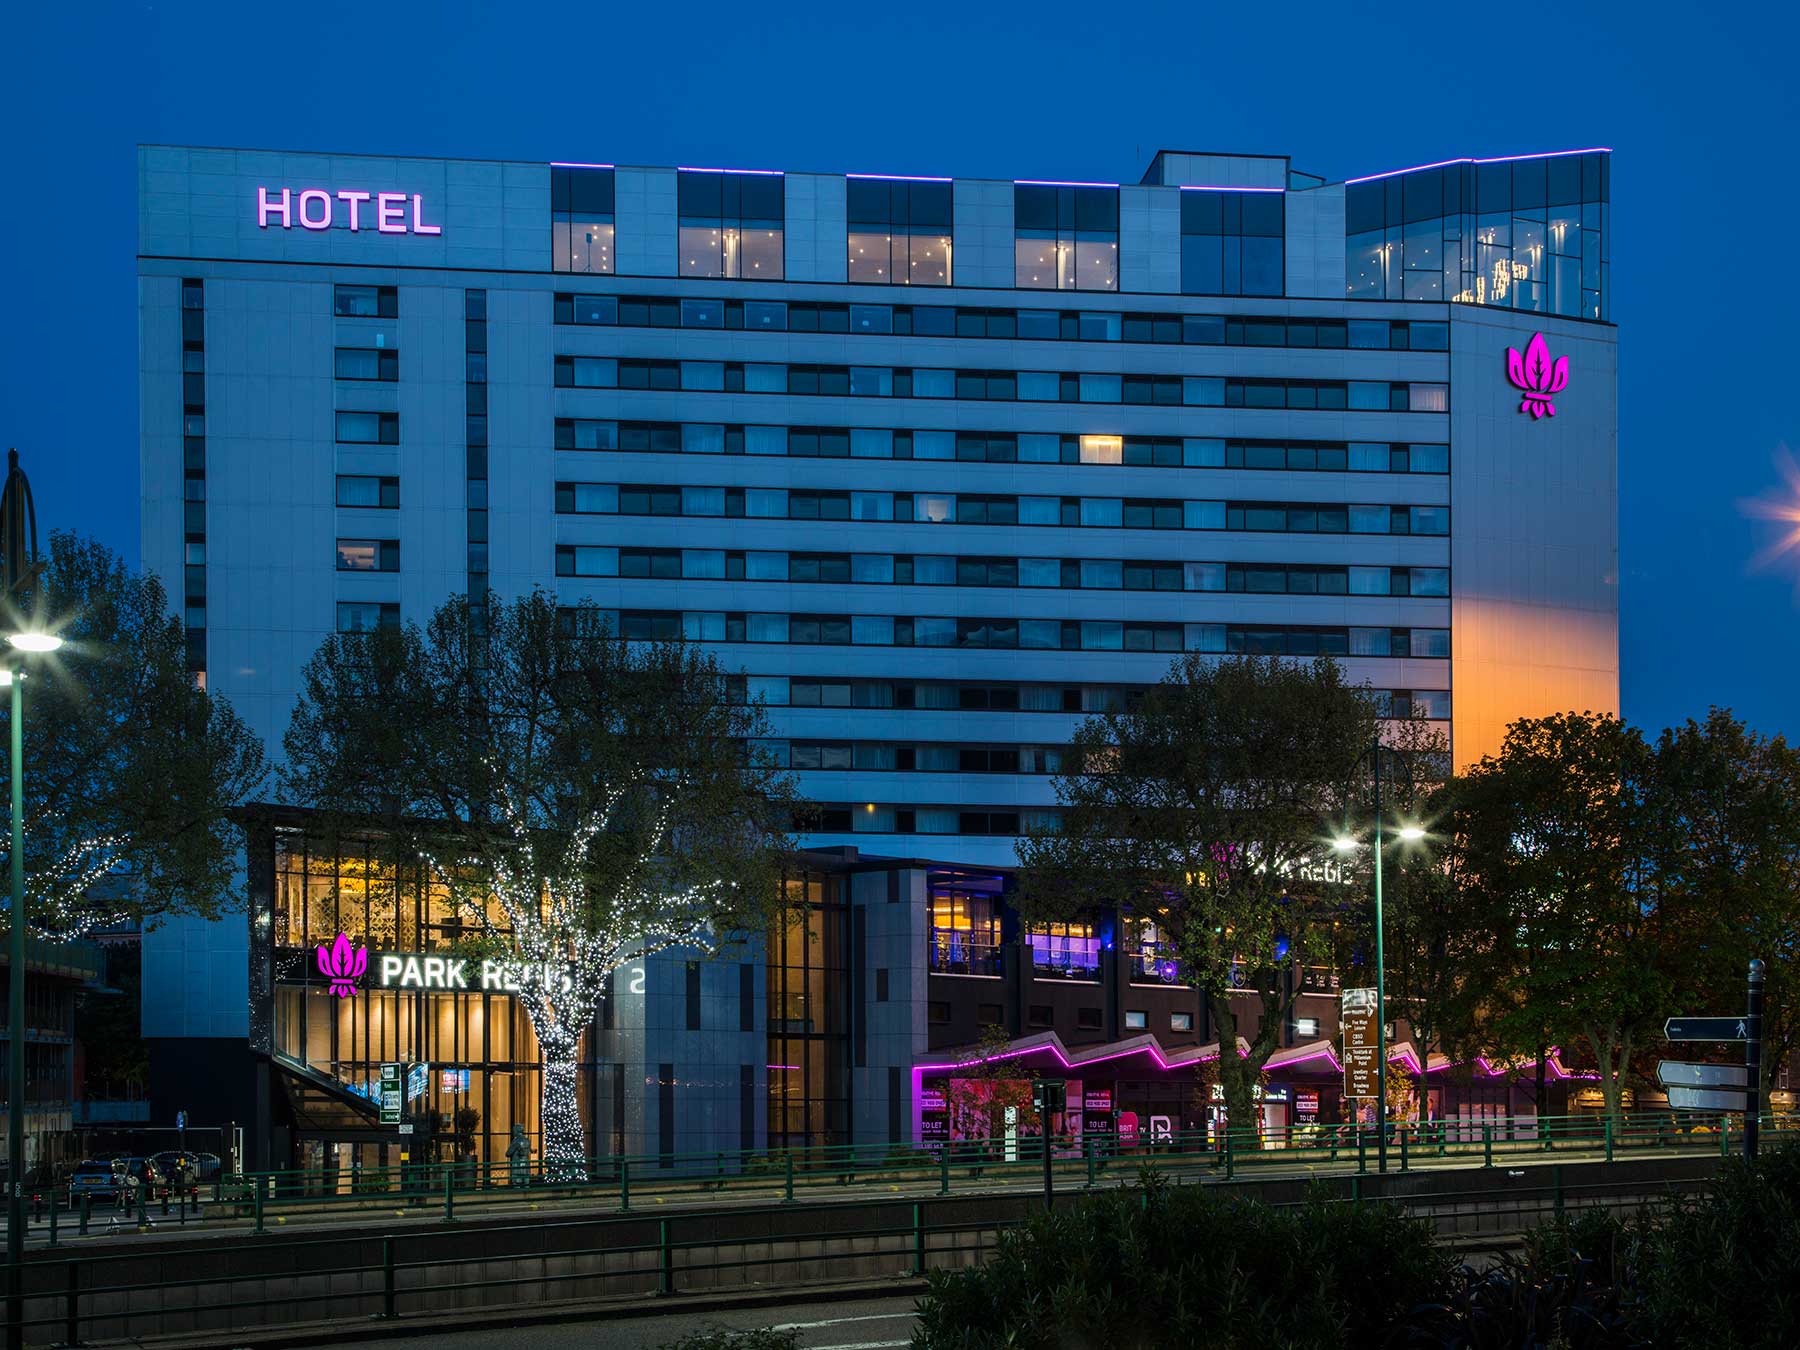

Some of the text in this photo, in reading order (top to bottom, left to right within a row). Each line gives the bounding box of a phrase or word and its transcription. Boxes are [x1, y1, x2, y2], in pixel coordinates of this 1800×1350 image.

[258, 187, 442, 235] HOTEL
[382, 956, 467, 988] PARK
[931, 1121, 943, 1129] LET
[1119, 1124, 1133, 1132] BRIT
